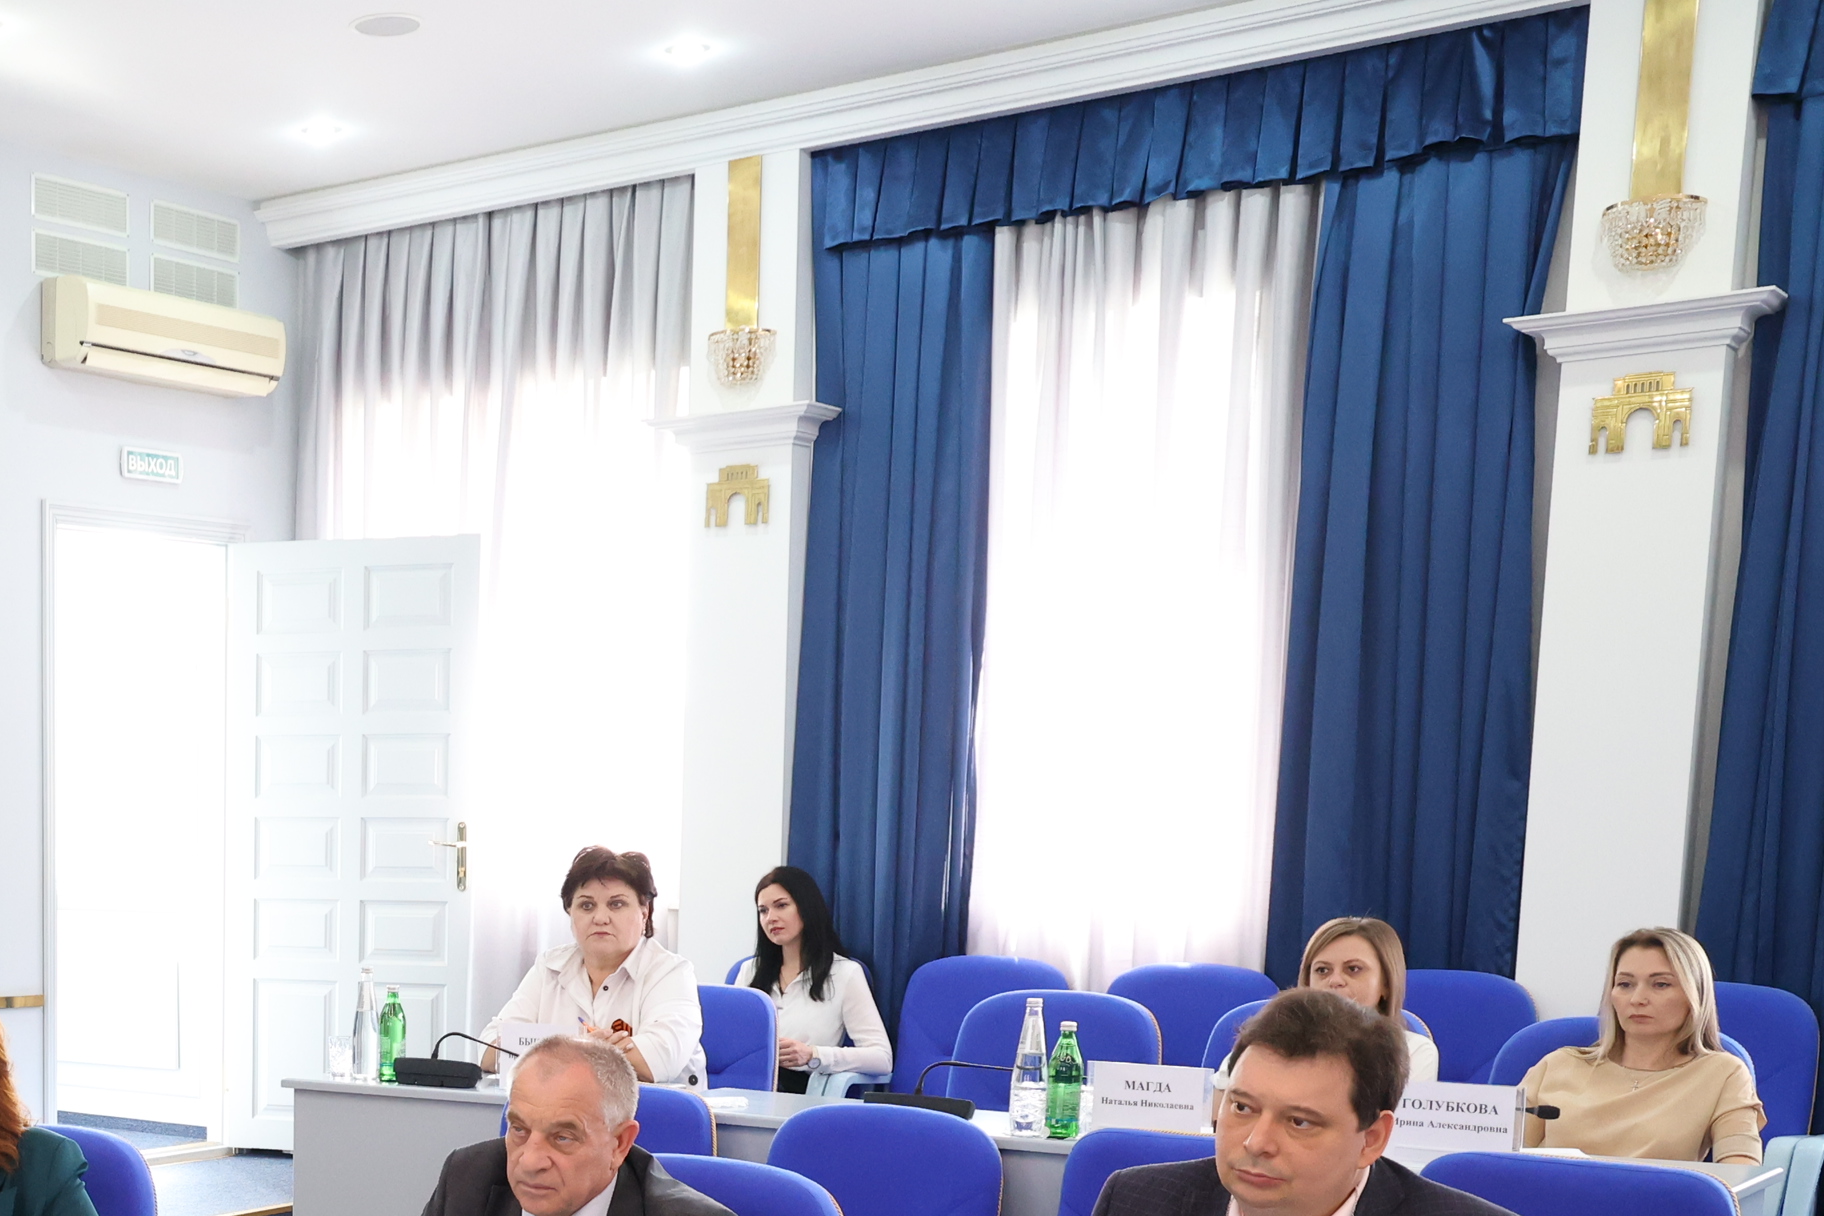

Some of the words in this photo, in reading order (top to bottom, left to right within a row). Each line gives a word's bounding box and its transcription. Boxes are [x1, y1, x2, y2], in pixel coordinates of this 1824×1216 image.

[128, 455, 176, 476] ВЫХОД
[1124, 1080, 1172, 1093] МАГДА
[1101, 1096, 1138, 1106] Наталья
[1140, 1099, 1194, 1110] Николаевна
[1402, 1098, 1499, 1116] ГОЛУБКОВА
[1427, 1120, 1508, 1134] Александровна
